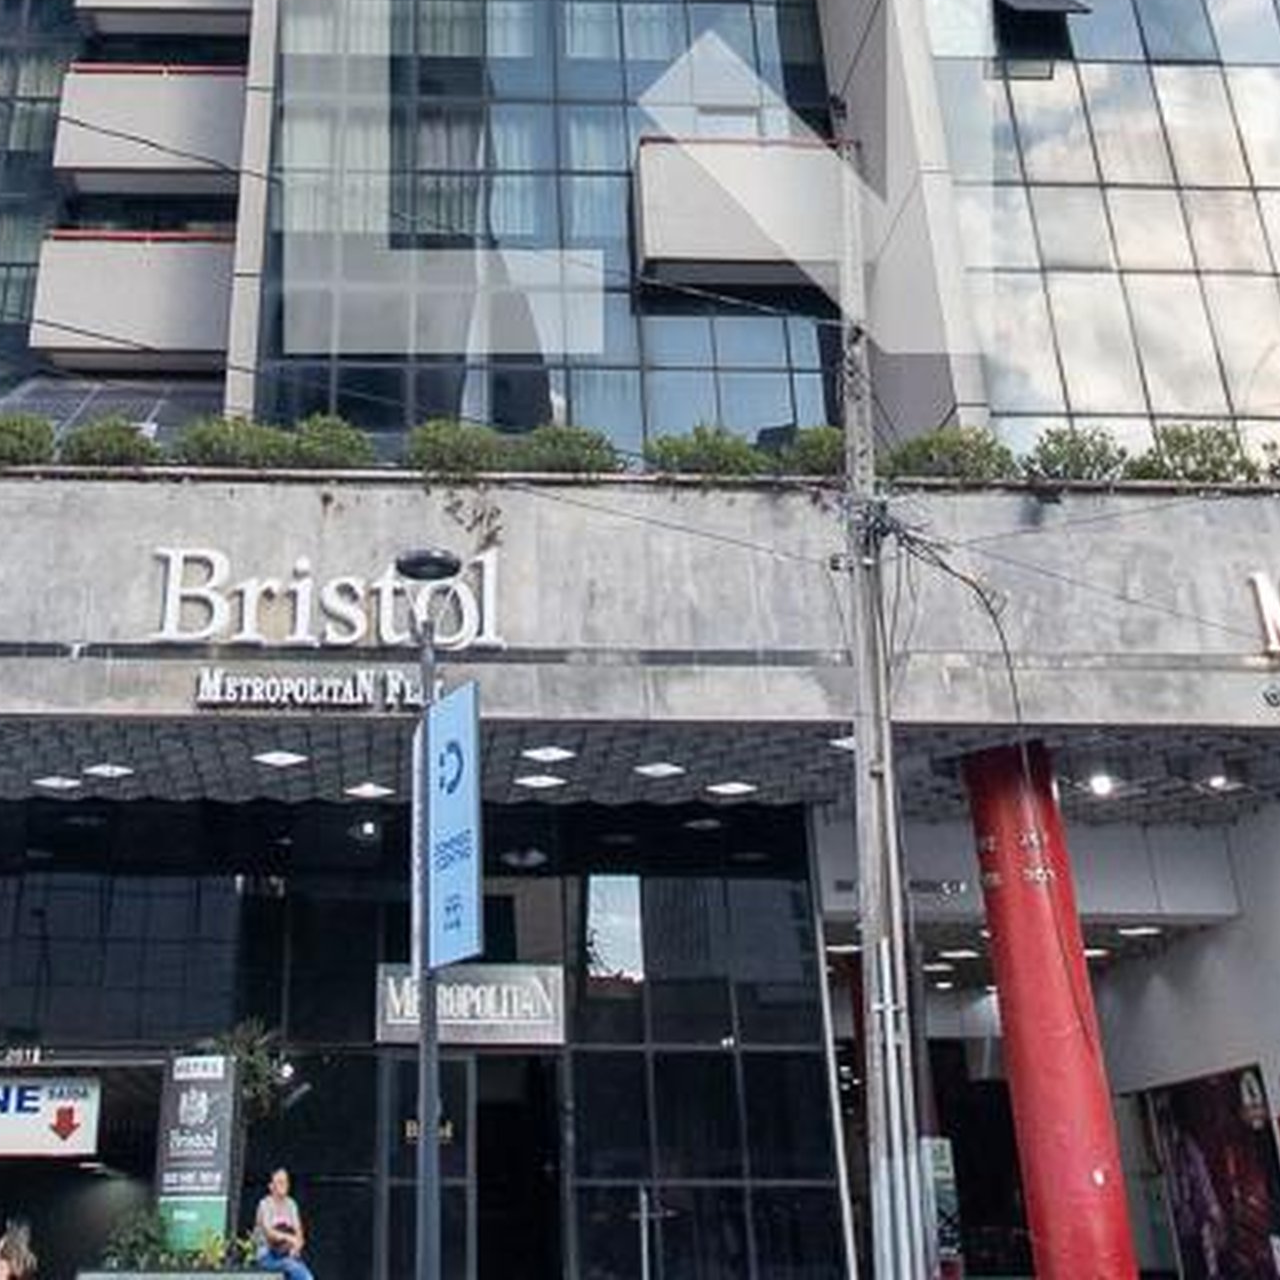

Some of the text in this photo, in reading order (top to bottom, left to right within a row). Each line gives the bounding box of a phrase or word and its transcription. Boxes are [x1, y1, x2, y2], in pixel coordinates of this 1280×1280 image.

[148, 546, 508, 650] Bristol
[197, 668, 372, 706] METROPOLITAN
[387, 975, 557, 1019] MEROPOLITAN
